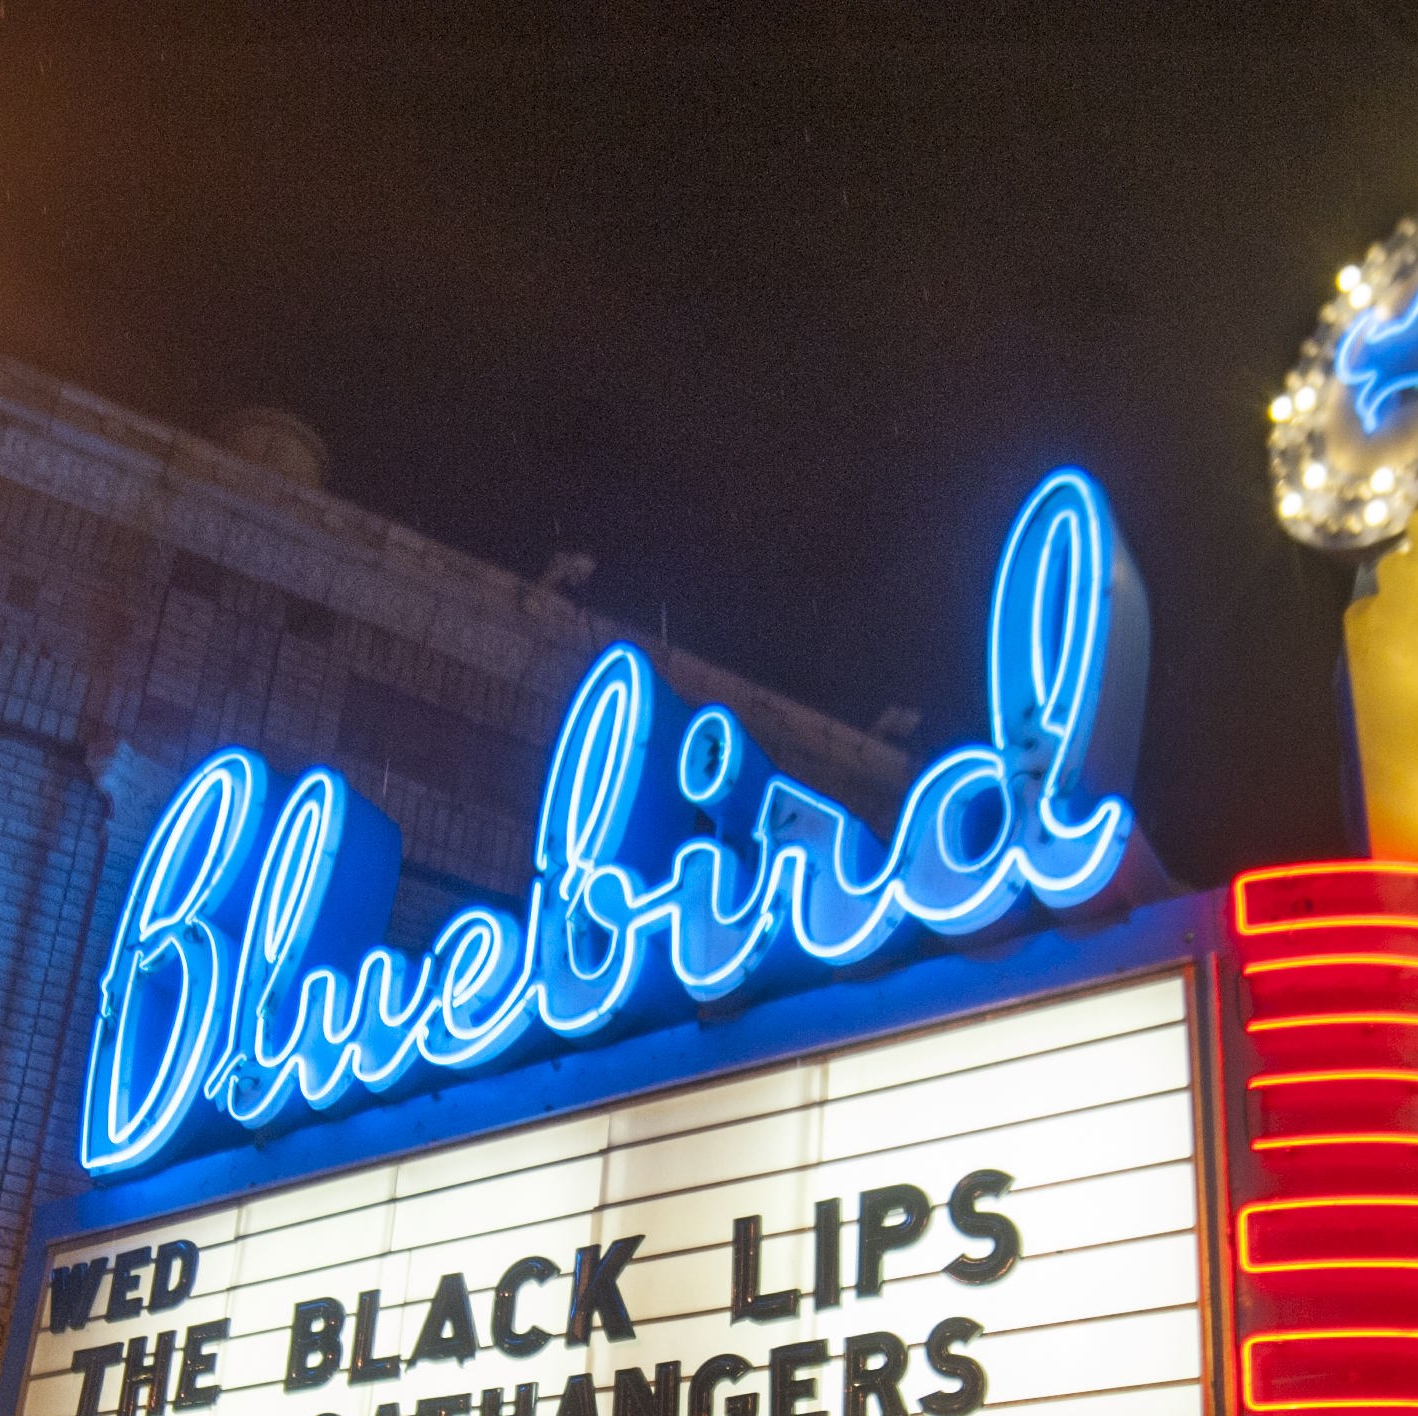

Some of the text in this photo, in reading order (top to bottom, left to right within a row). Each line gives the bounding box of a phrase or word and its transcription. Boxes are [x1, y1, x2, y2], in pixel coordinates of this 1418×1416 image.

[80, 465, 1134, 1176] Bluebird
[49, 1238, 200, 1334] WED
[283, 1234, 646, 1393] BLACK
[730, 1168, 1023, 1327] LIPS
